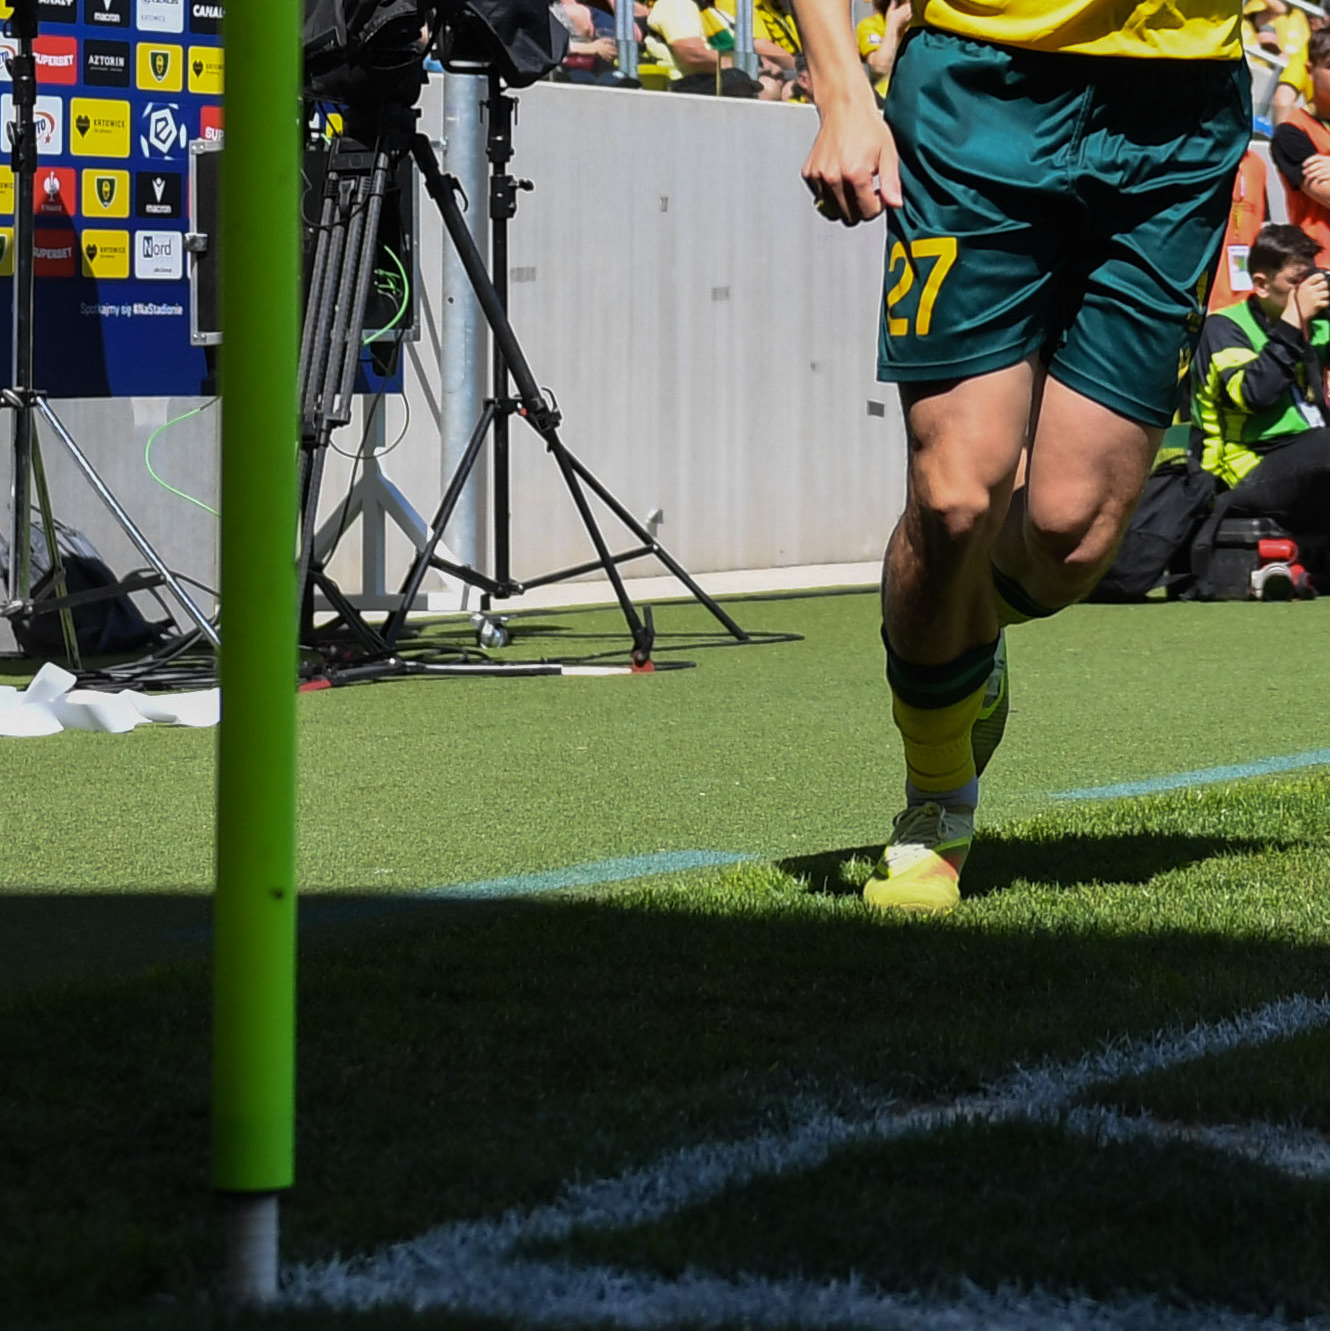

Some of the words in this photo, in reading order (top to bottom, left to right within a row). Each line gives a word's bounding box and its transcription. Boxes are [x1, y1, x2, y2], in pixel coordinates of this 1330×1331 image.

[88, 54, 125, 67] AZTORIN
[93, 118, 126, 129] KATOWICE
[142, 235, 172, 259] Nord
[886, 236, 958, 337] 27
